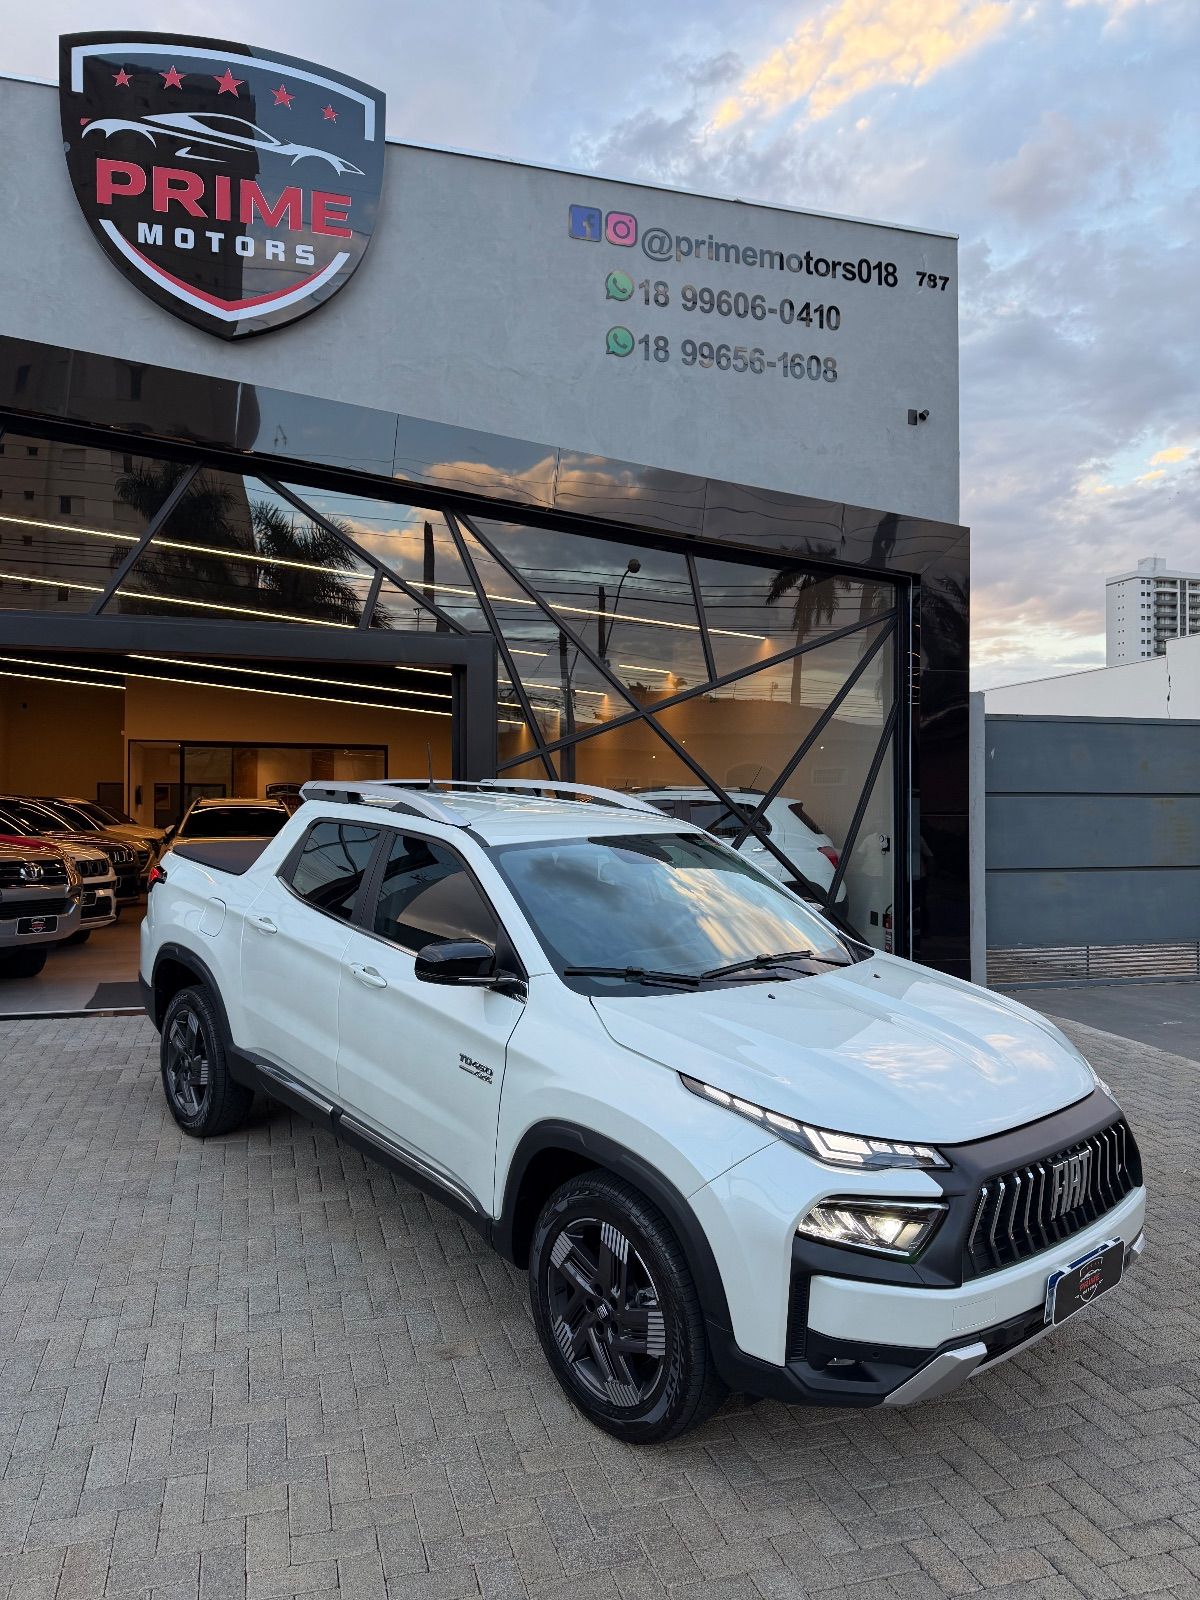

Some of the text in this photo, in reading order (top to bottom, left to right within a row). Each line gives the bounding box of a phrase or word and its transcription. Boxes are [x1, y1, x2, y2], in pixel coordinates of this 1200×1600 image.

[96, 158, 353, 239] PRIME
[137, 222, 316, 266] MOTORS
[641, 227, 898, 288] @primemotors018
[638, 279, 841, 331] 18 99606-0410
[915, 271, 950, 292] 787
[638, 334, 838, 383] 18 99656-1608
[1051, 1149, 1090, 1221] FIAT
